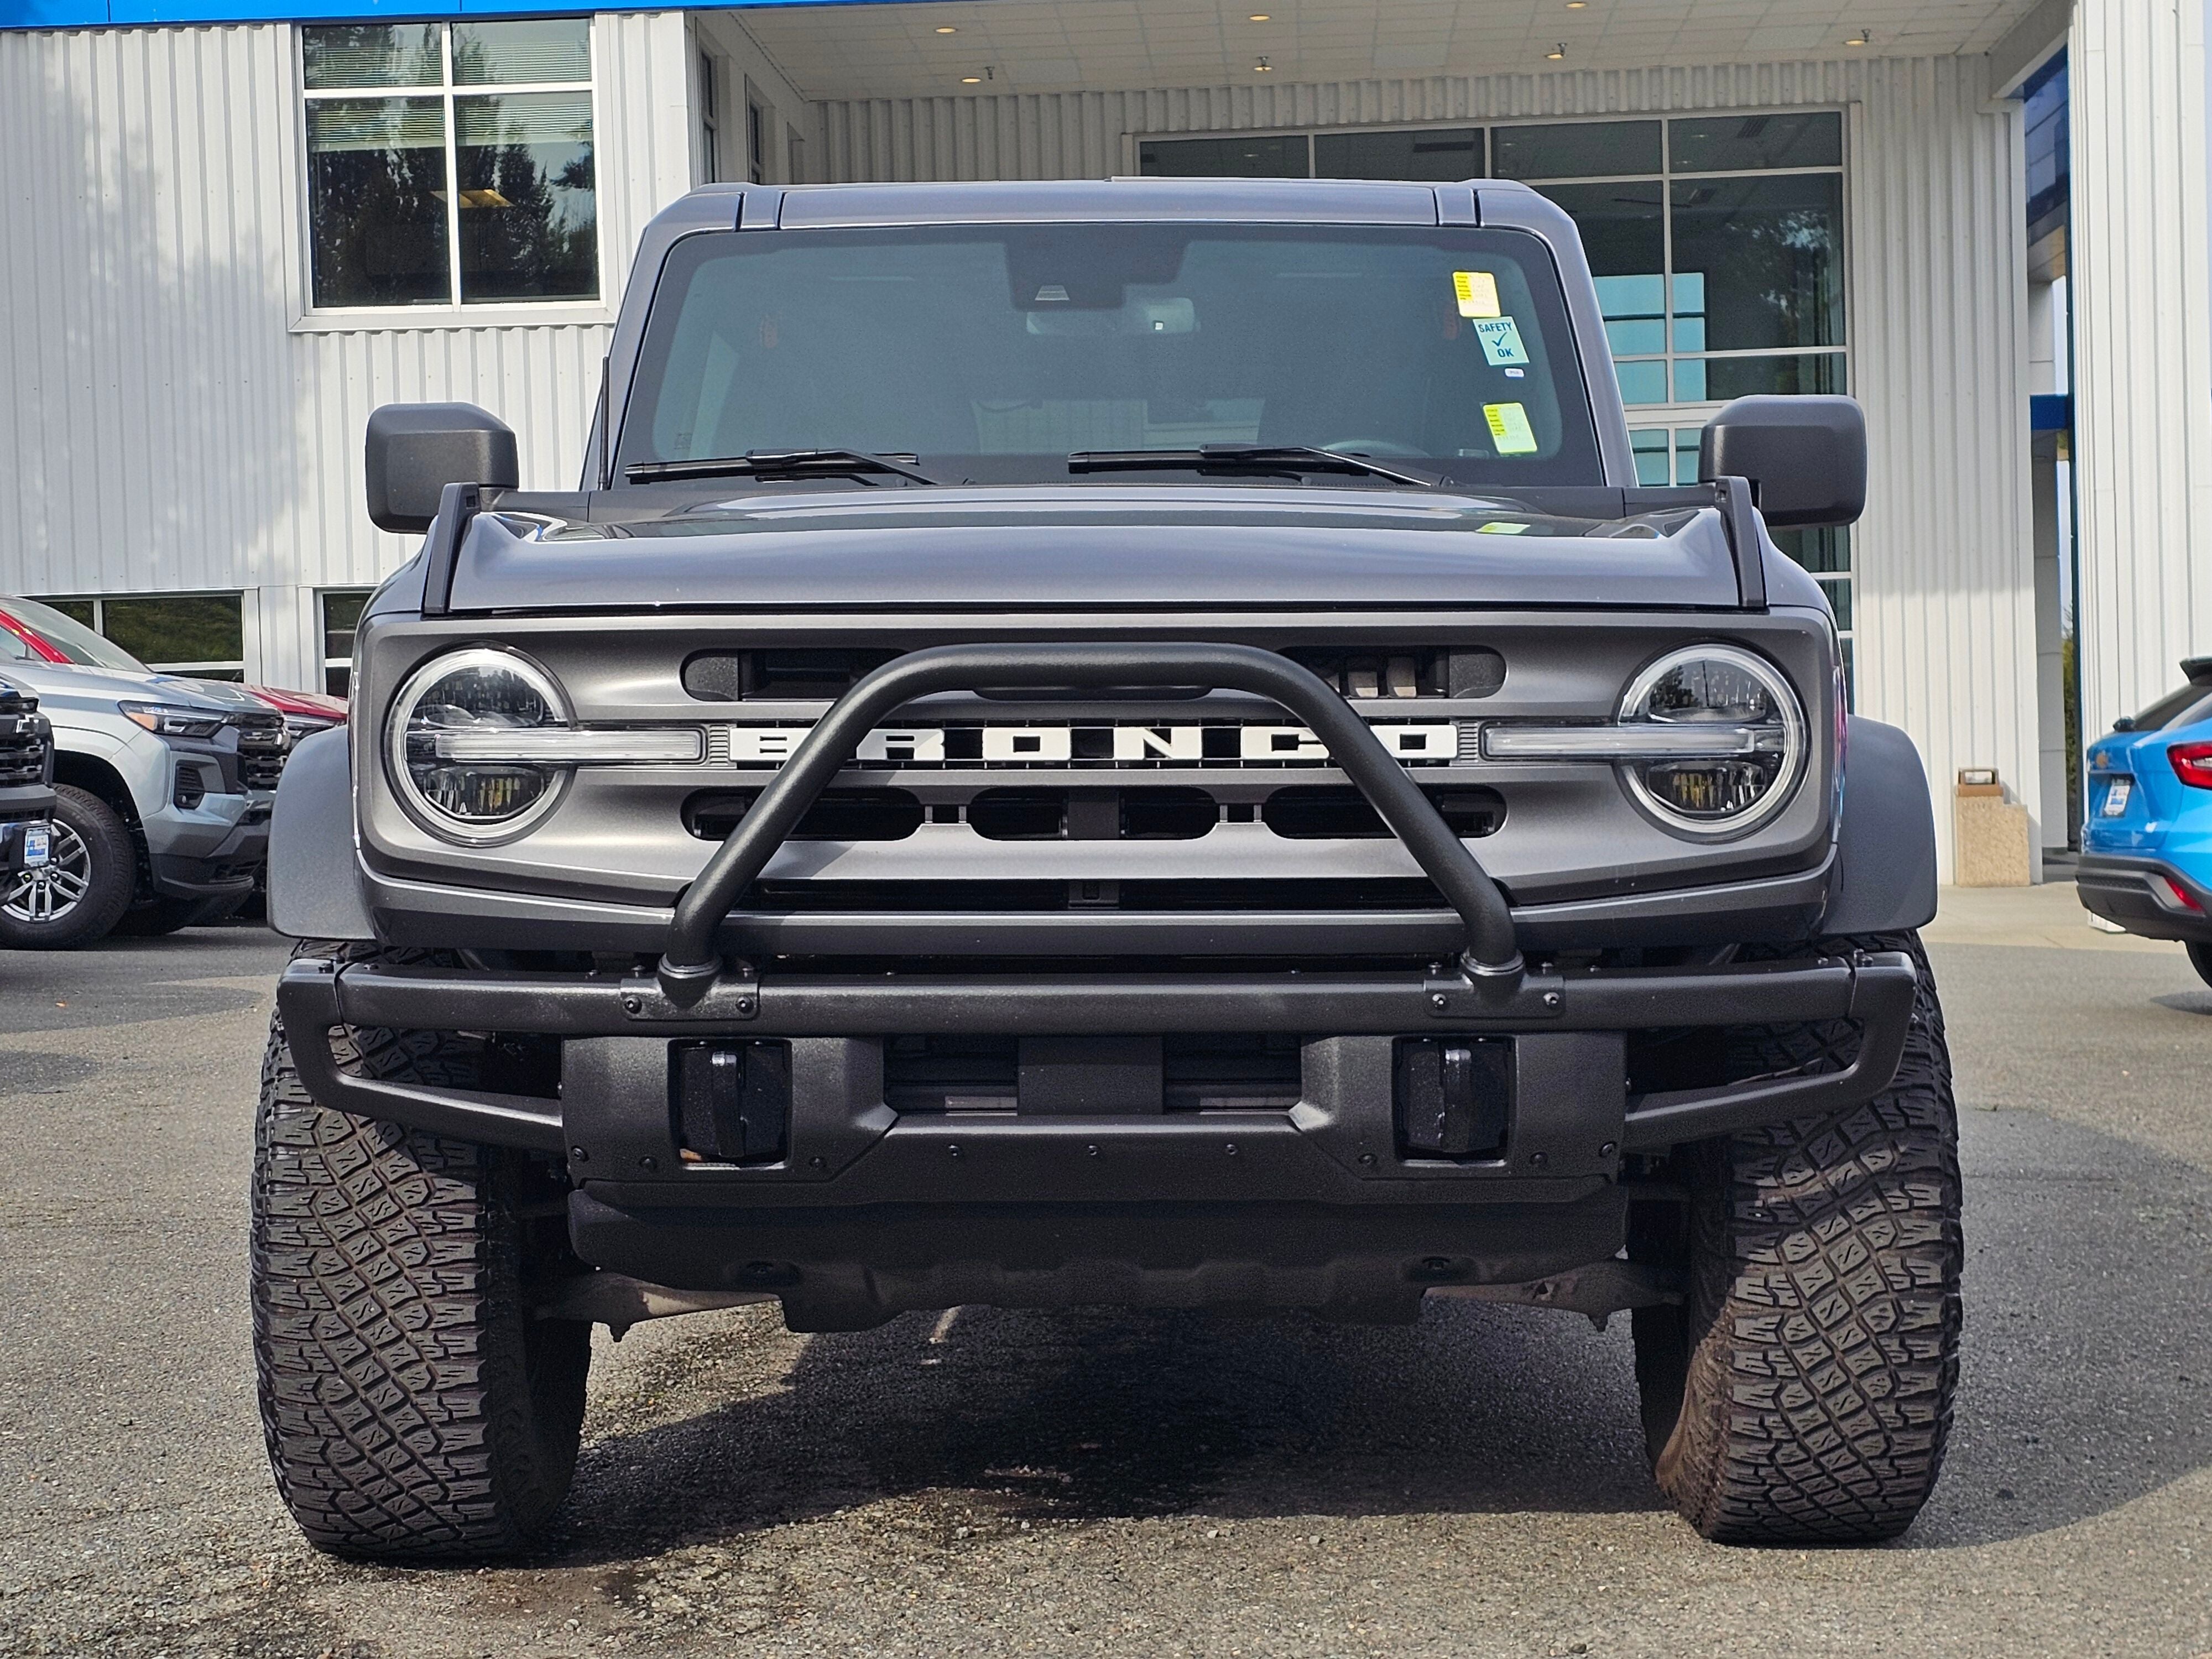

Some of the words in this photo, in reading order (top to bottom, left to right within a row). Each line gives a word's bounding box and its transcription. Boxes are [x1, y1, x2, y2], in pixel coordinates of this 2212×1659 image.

[1478, 322, 1512, 332] SAFETY
[1498, 348, 1514, 357] OK
[729, 724, 1458, 761] BRONCO
